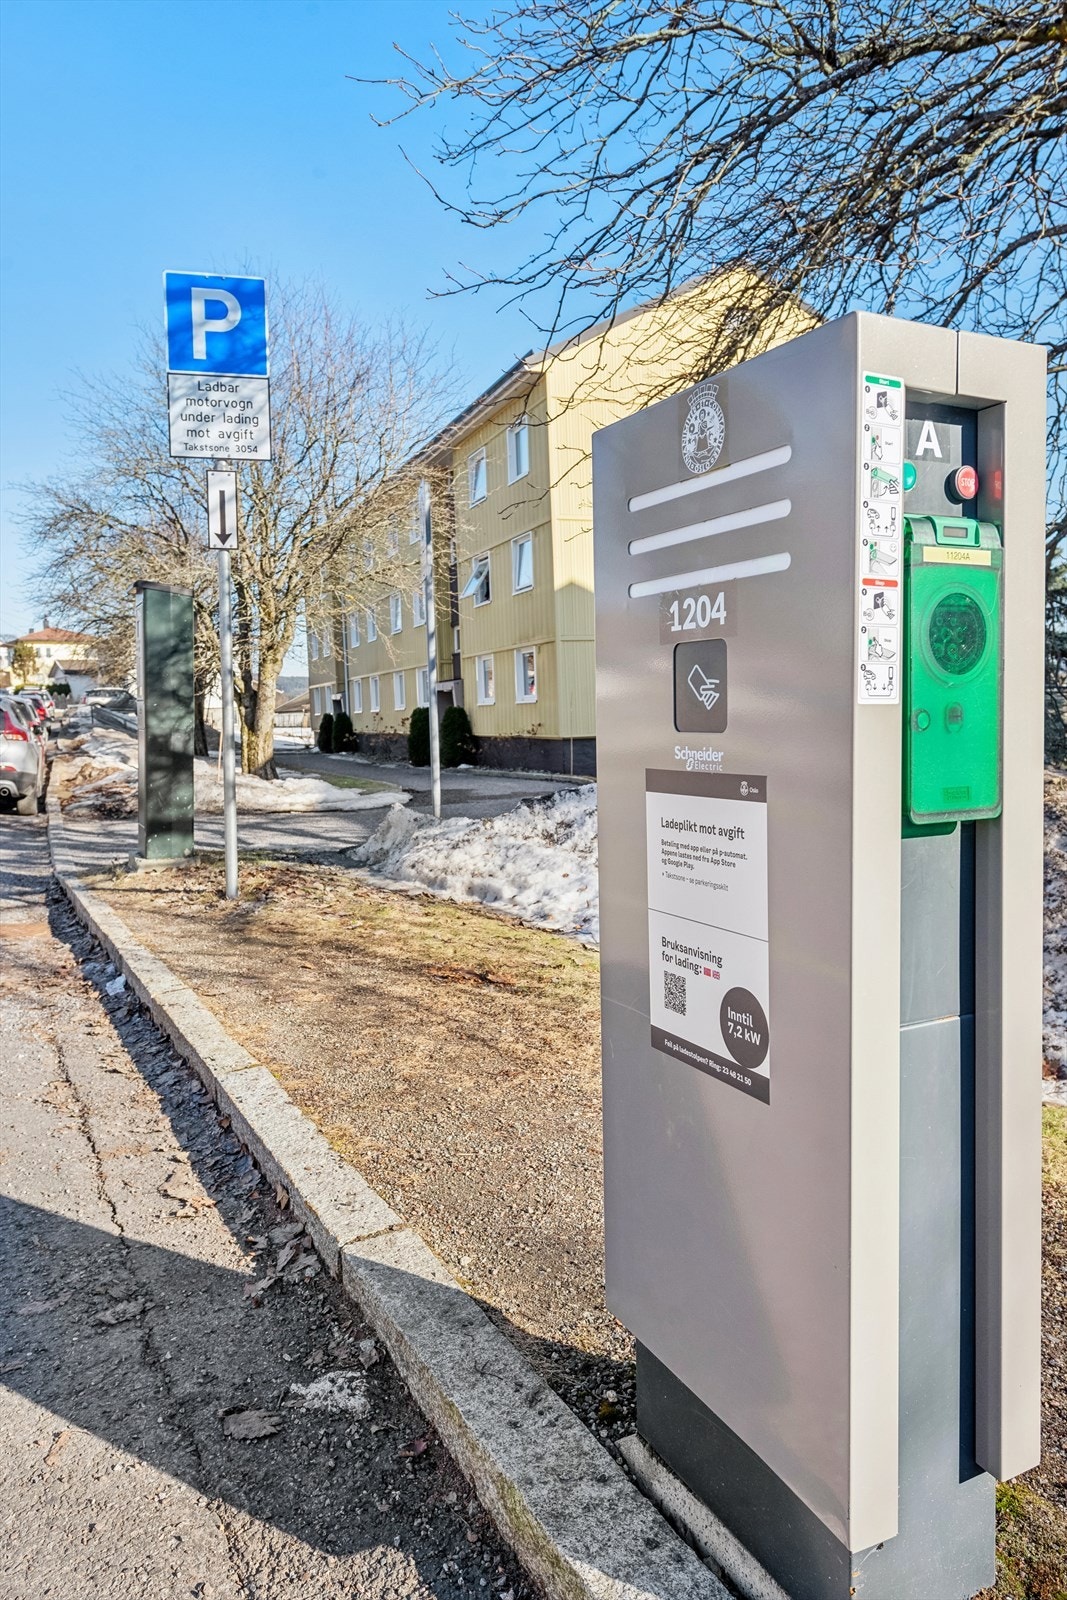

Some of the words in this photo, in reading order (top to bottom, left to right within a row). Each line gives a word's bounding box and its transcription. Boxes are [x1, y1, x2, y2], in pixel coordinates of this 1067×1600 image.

[191, 287, 242, 360] P
[197, 380, 240, 393] Ladbar
[186, 397, 253, 411] motorvogn
[180, 411, 216, 423] under
[223, 412, 259, 427] lading
[186, 428, 210, 438] mot
[218, 429, 254, 442] avgift
[915, 420, 943, 458] A
[183, 442, 230, 453] Takstsone
[235, 444, 258, 453] 3054
[961, 478, 975, 488] STOP
[946, 551, 971, 561] 11204A
[669, 591, 727, 632] 1204
[674, 745, 724, 762] Schneider
[694, 761, 723, 772] Electric
[661, 817, 698, 833] Ladeplikt
[699, 824, 717, 836] mot
[718, 826, 745, 841] avgift
[661, 839, 680, 850] Betaling
[700, 846, 711, 854] eller
[712, 848, 718, 856] på
[719, 850, 748, 861] p-automat.
[661, 848, 677, 857] Appene
[678, 851, 692, 860] lastes
[701, 855, 710, 863] fra
[710, 857, 721, 866] App
[721, 858, 736, 868] Store
[668, 858, 683, 868] Google
[661, 936, 723, 968] Bruksanvisning
[661, 951, 674, 963] for
[674, 956, 703, 975] lading:
[727, 1007, 754, 1028] Inntil
[727, 1022, 743, 1039] 7,2
[744, 1028, 761, 1046] kW
[664, 1039, 673, 1049] Feil
[708, 1060, 722, 1073] Ring:
[722, 1066, 729, 1075] 23
[744, 1077, 752, 1086] 50
